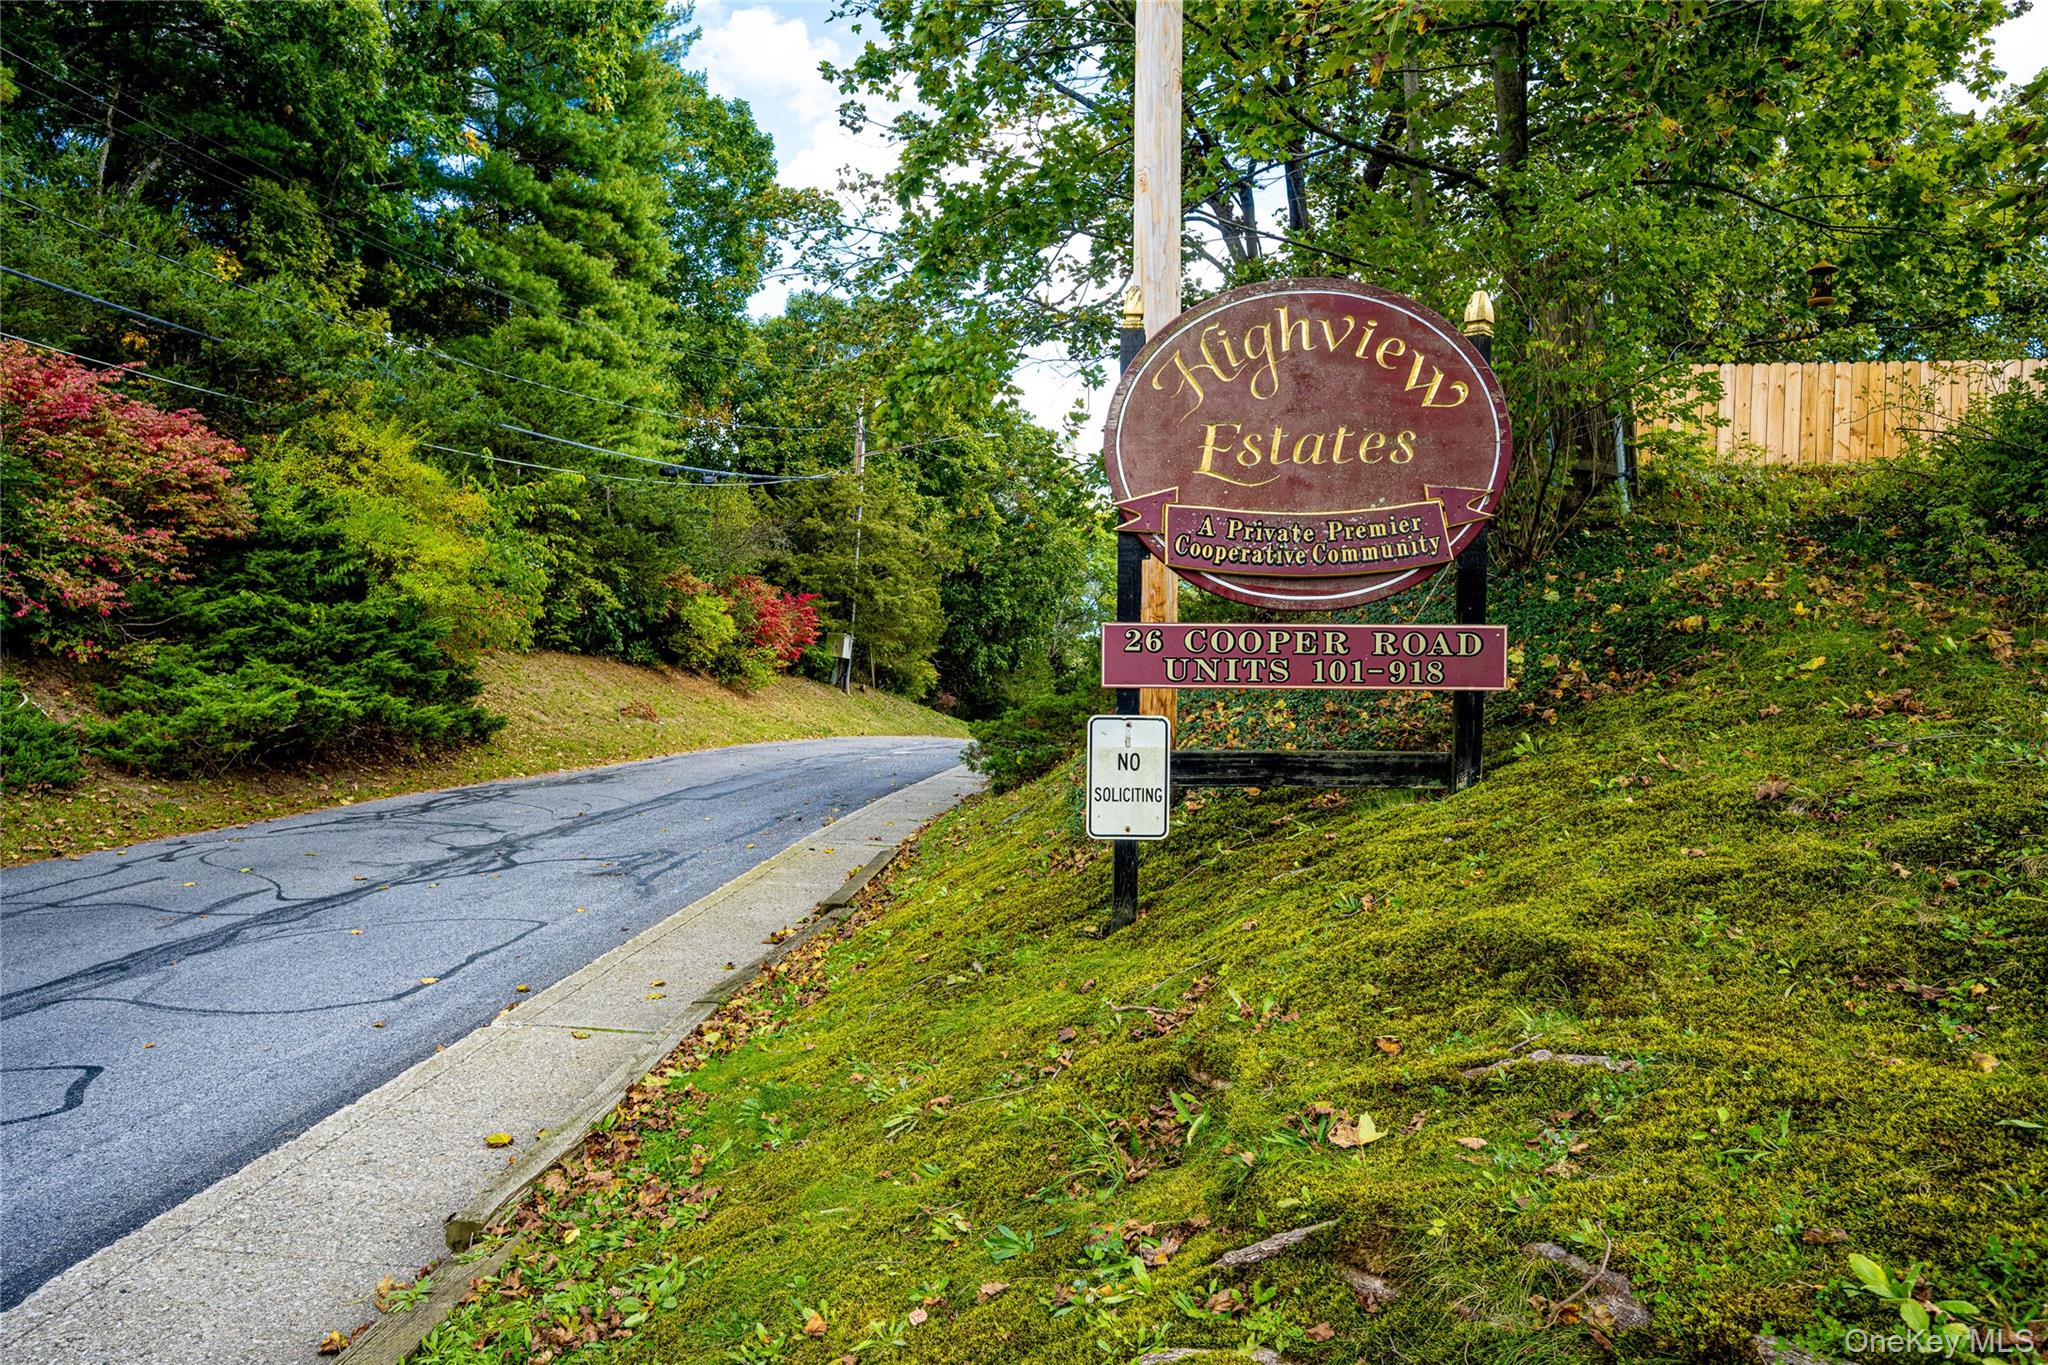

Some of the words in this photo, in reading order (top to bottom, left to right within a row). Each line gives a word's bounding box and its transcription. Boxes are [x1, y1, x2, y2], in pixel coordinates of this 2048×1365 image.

[1152, 305, 1470, 423] Highview
[1193, 422, 1417, 487] Estates
[1197, 514, 1216, 537] A
[1226, 517, 1315, 543] Private
[1327, 514, 1422, 541] Premier
[1174, 534, 1307, 565] Cooperative
[1312, 532, 1441, 564] Community
[1123, 628, 1164, 653] 26
[1184, 628, 1350, 656] COOPER
[1372, 631, 1484, 657] ROAD
[1164, 657, 1290, 682] UNITS
[1313, 659, 1445, 684] 101-918
[1117, 752, 1141, 771] NO
[1093, 786, 1163, 803] SOLICITING
